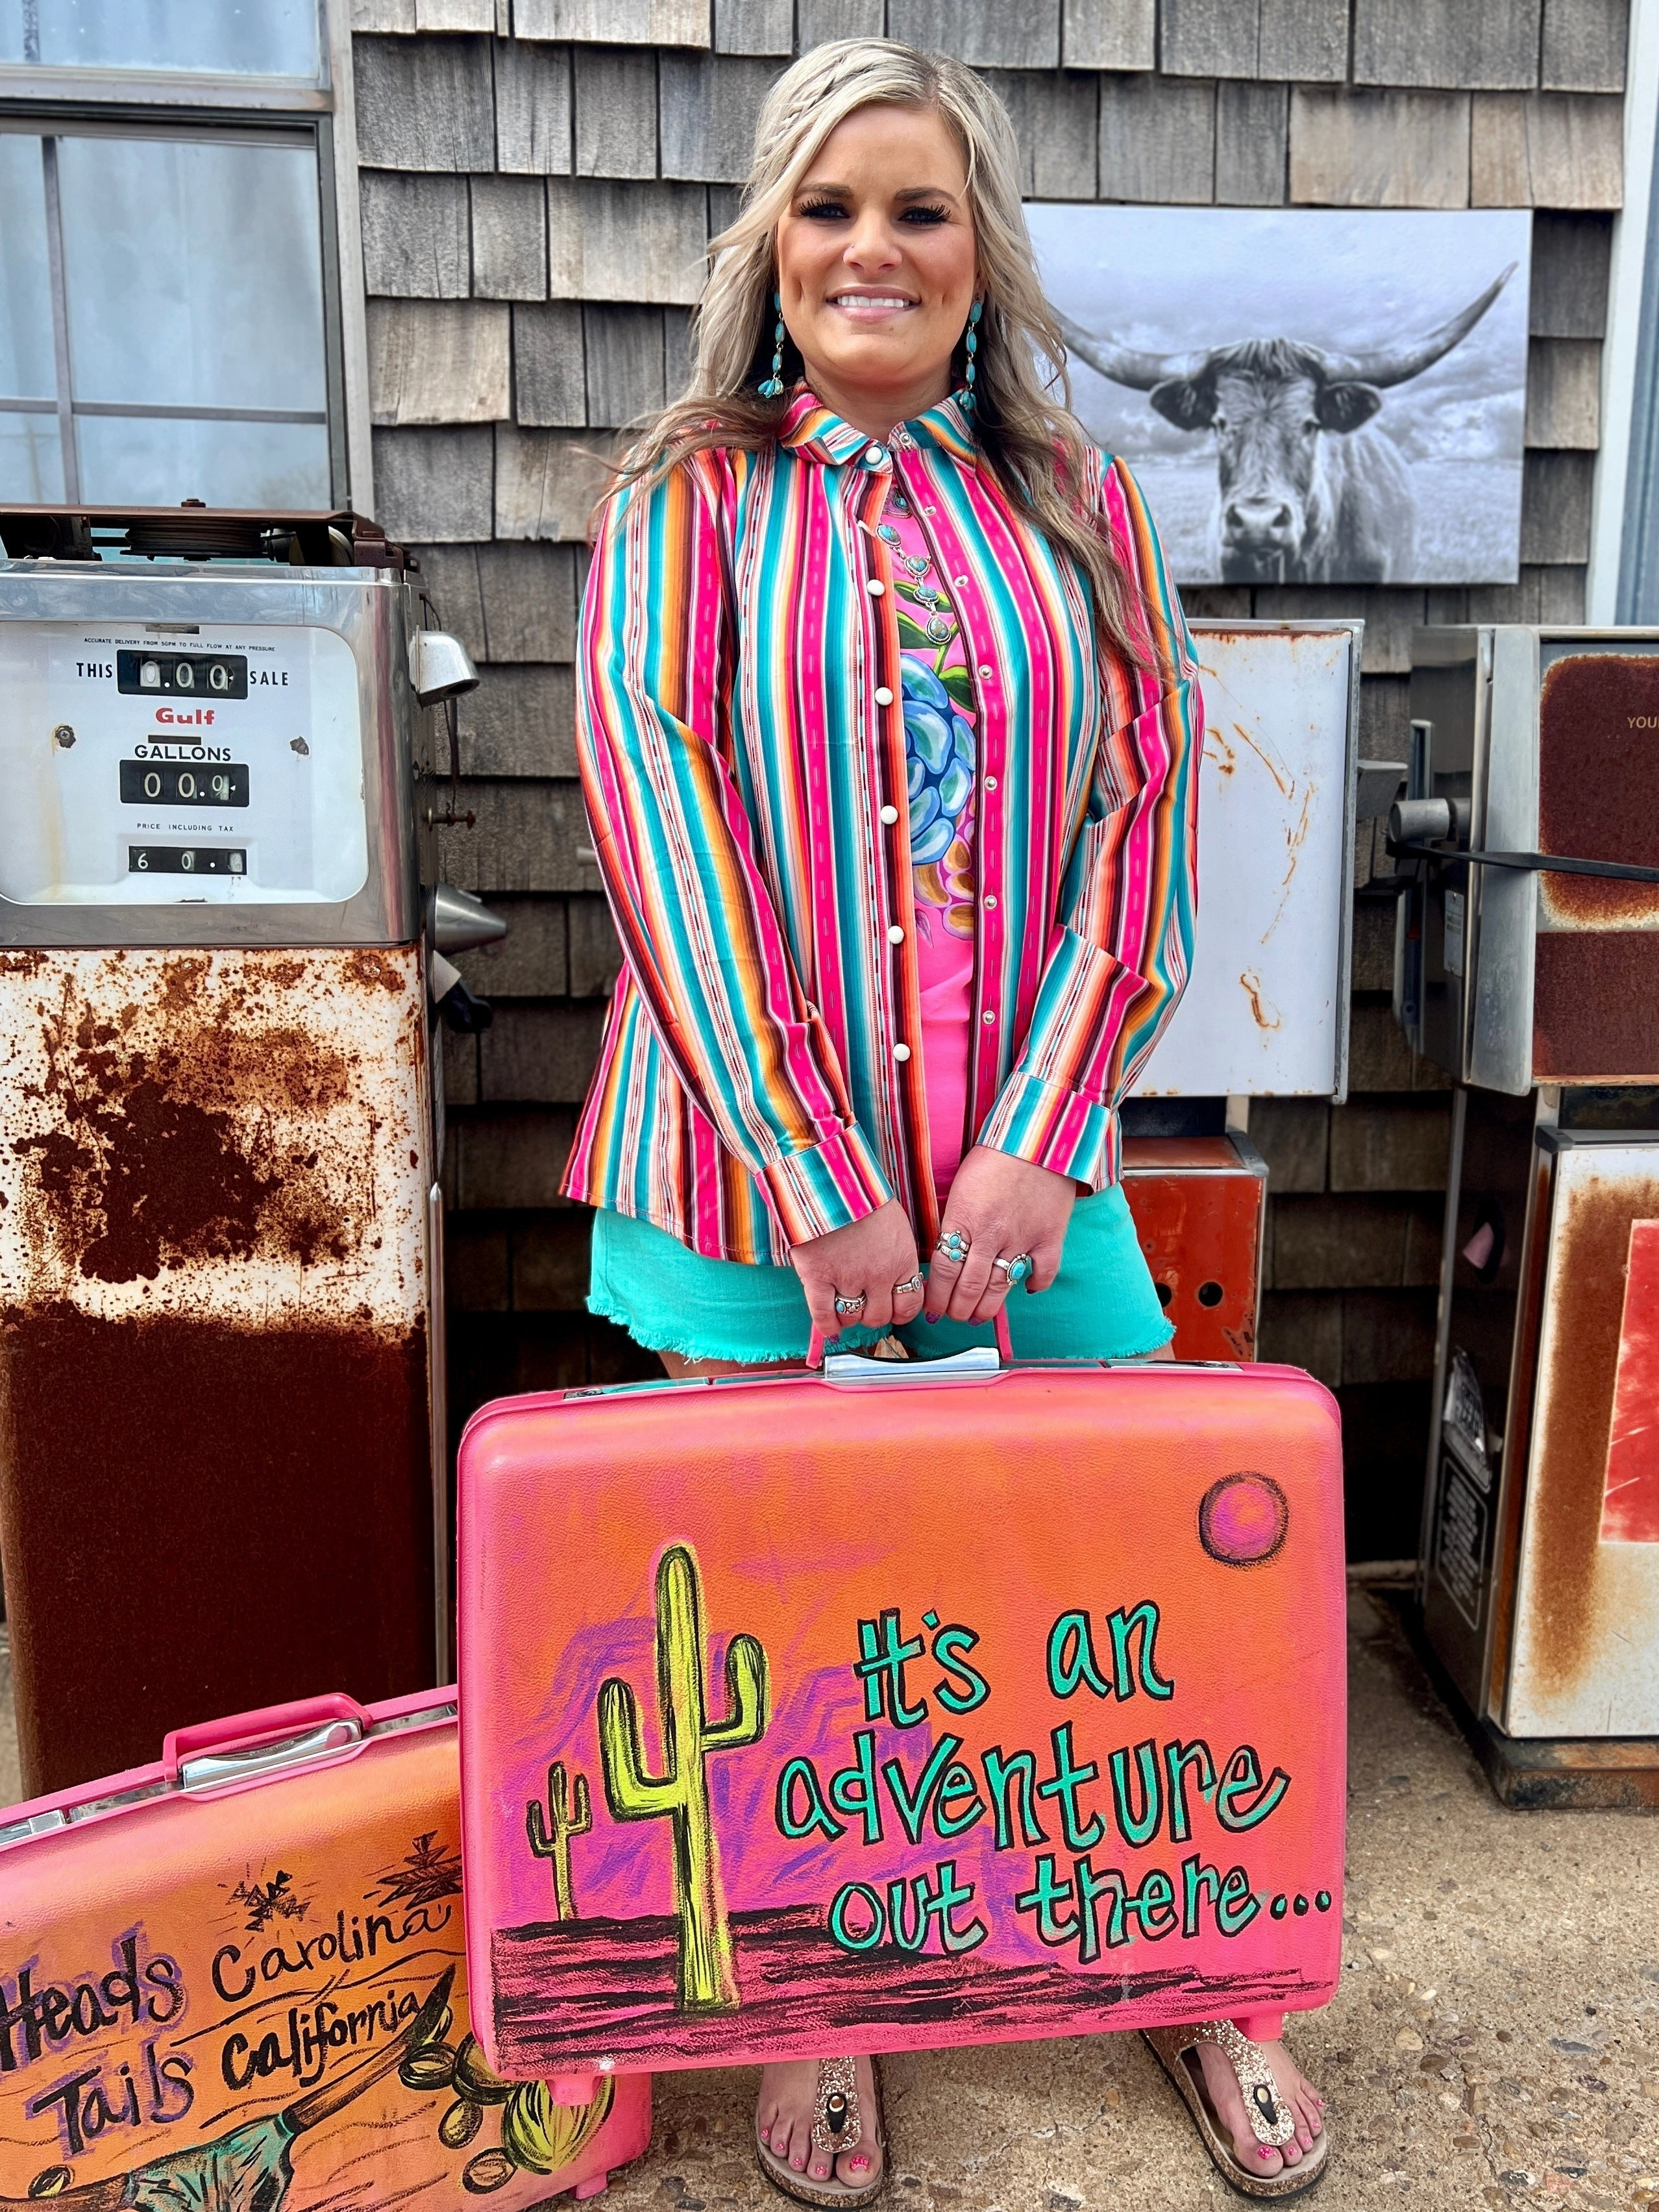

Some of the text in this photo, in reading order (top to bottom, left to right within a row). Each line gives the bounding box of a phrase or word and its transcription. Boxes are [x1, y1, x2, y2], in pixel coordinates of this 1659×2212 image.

[76, 662, 112, 678] THIS
[250, 670, 288, 686] SALE
[156, 707, 215, 725] Gulf
[1627, 716, 1659, 728] YOU
[134, 744, 231, 761] GALLONS
[855, 1600, 1175, 1729] It's an
[828, 1854, 1332, 1964] out there...
[0, 1904, 452, 2072] Heads Carolina
[31, 1989, 422, 2155] Tails California
